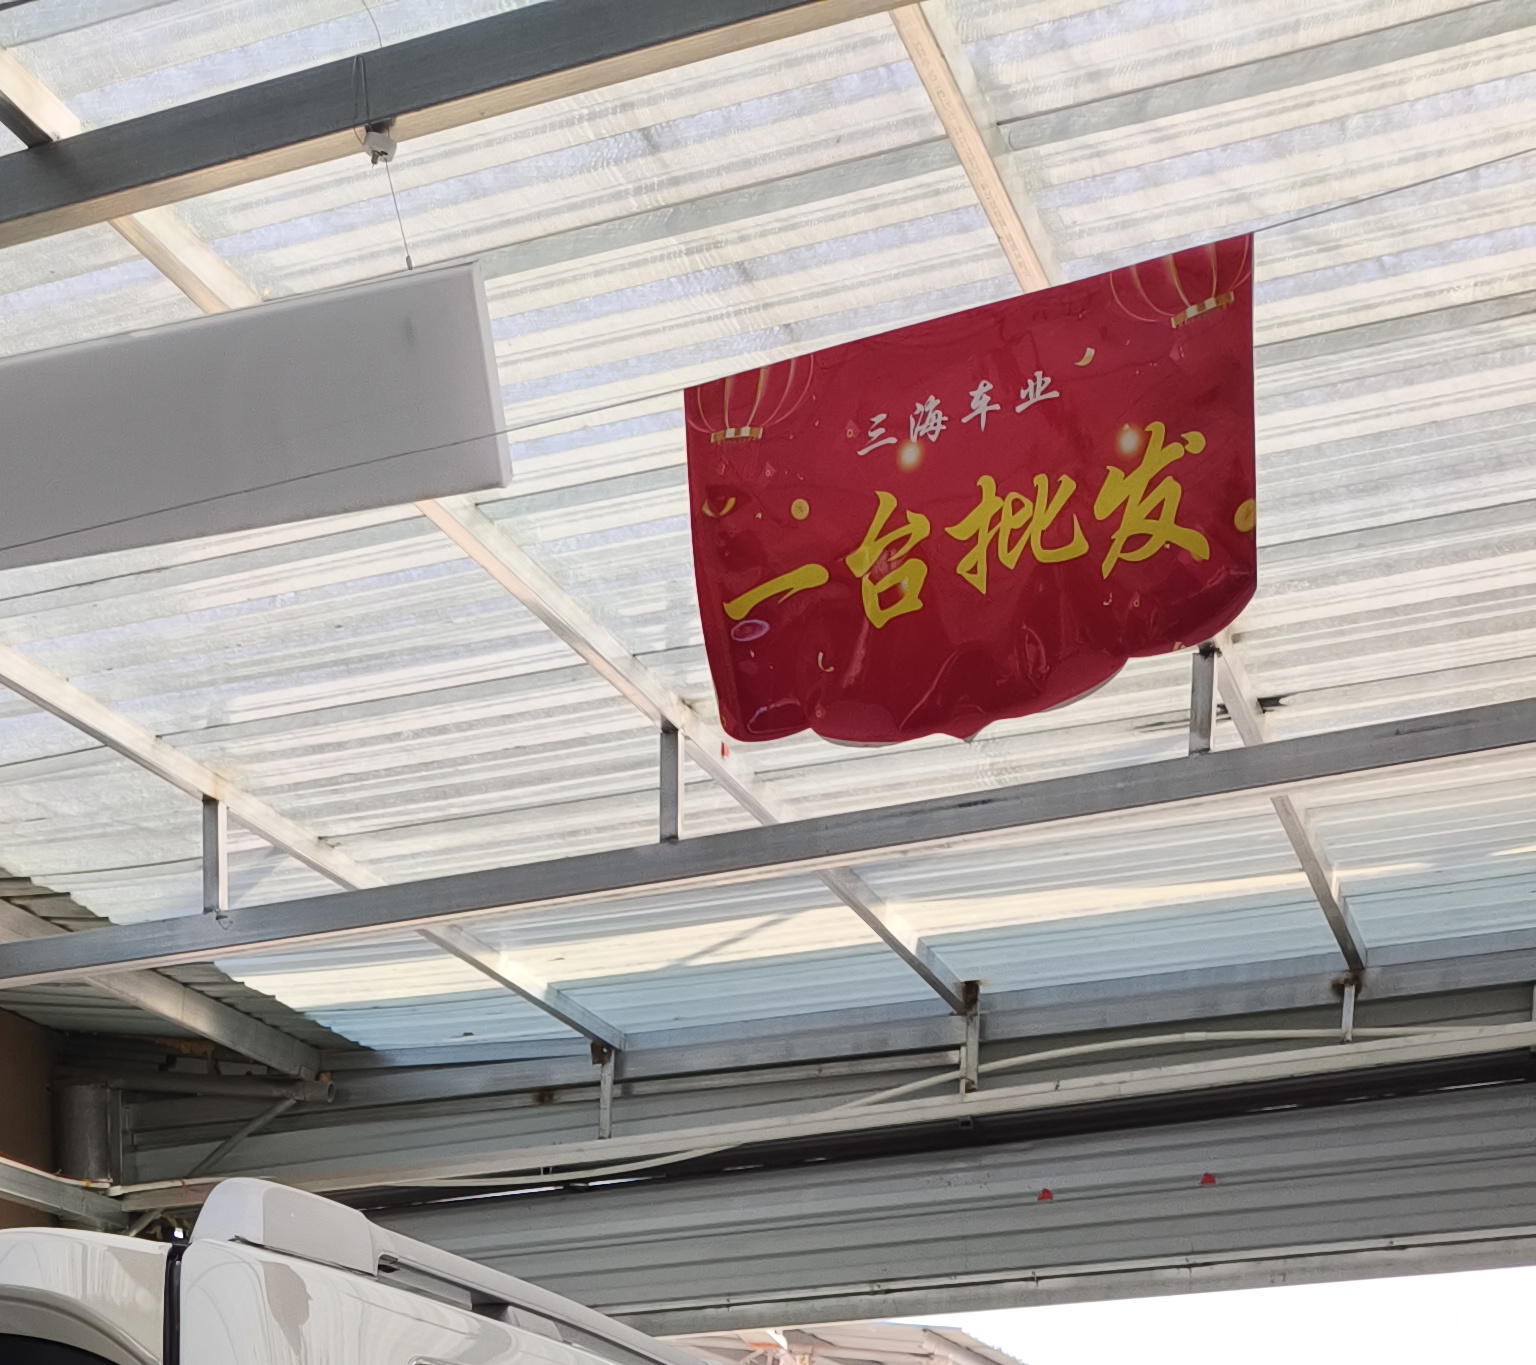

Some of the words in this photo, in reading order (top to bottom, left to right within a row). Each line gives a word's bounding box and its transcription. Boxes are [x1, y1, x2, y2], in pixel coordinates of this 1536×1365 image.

[857, 370, 1061, 457] 三海车业
[722, 421, 1211, 630] 一台批发
